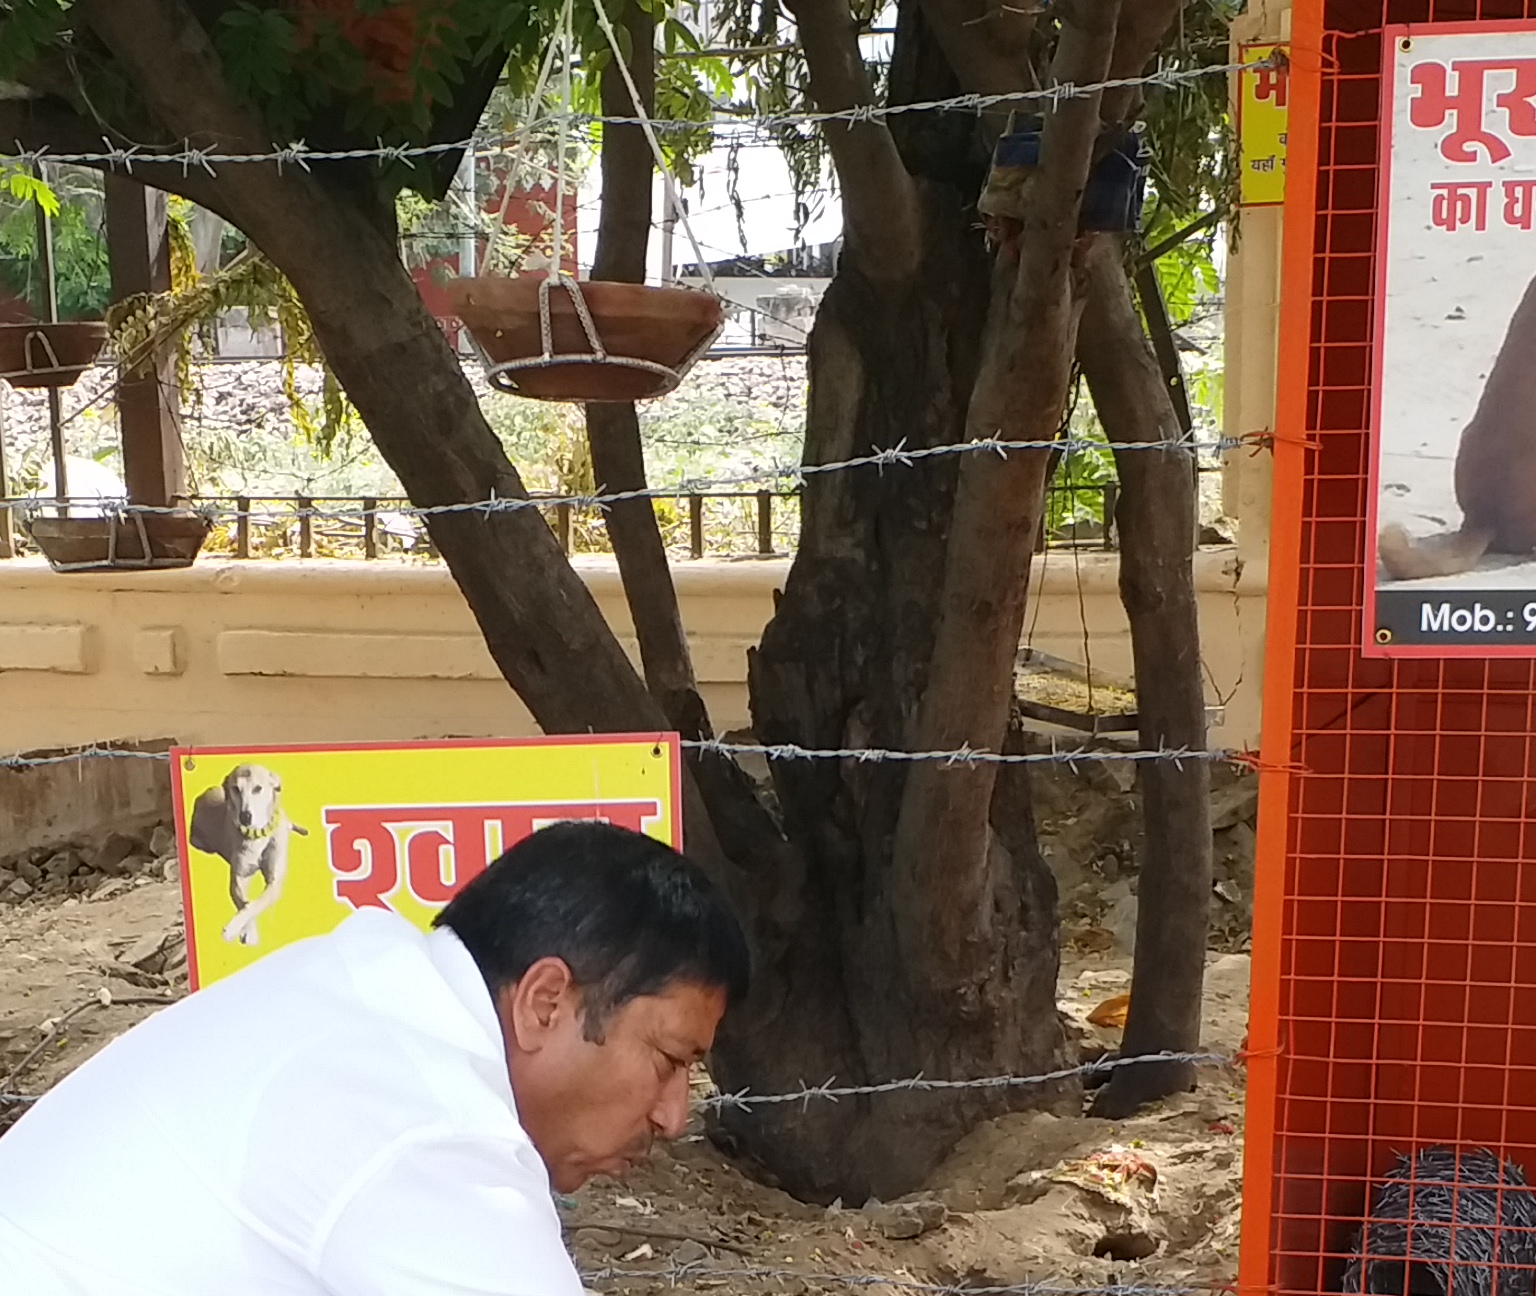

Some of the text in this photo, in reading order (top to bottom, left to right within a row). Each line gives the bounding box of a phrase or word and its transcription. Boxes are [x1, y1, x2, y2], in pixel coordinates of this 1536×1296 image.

[1430, 180, 1493, 232] का
[1420, 602, 1514, 633] Mob.:
[324, 801, 658, 912] श्व
